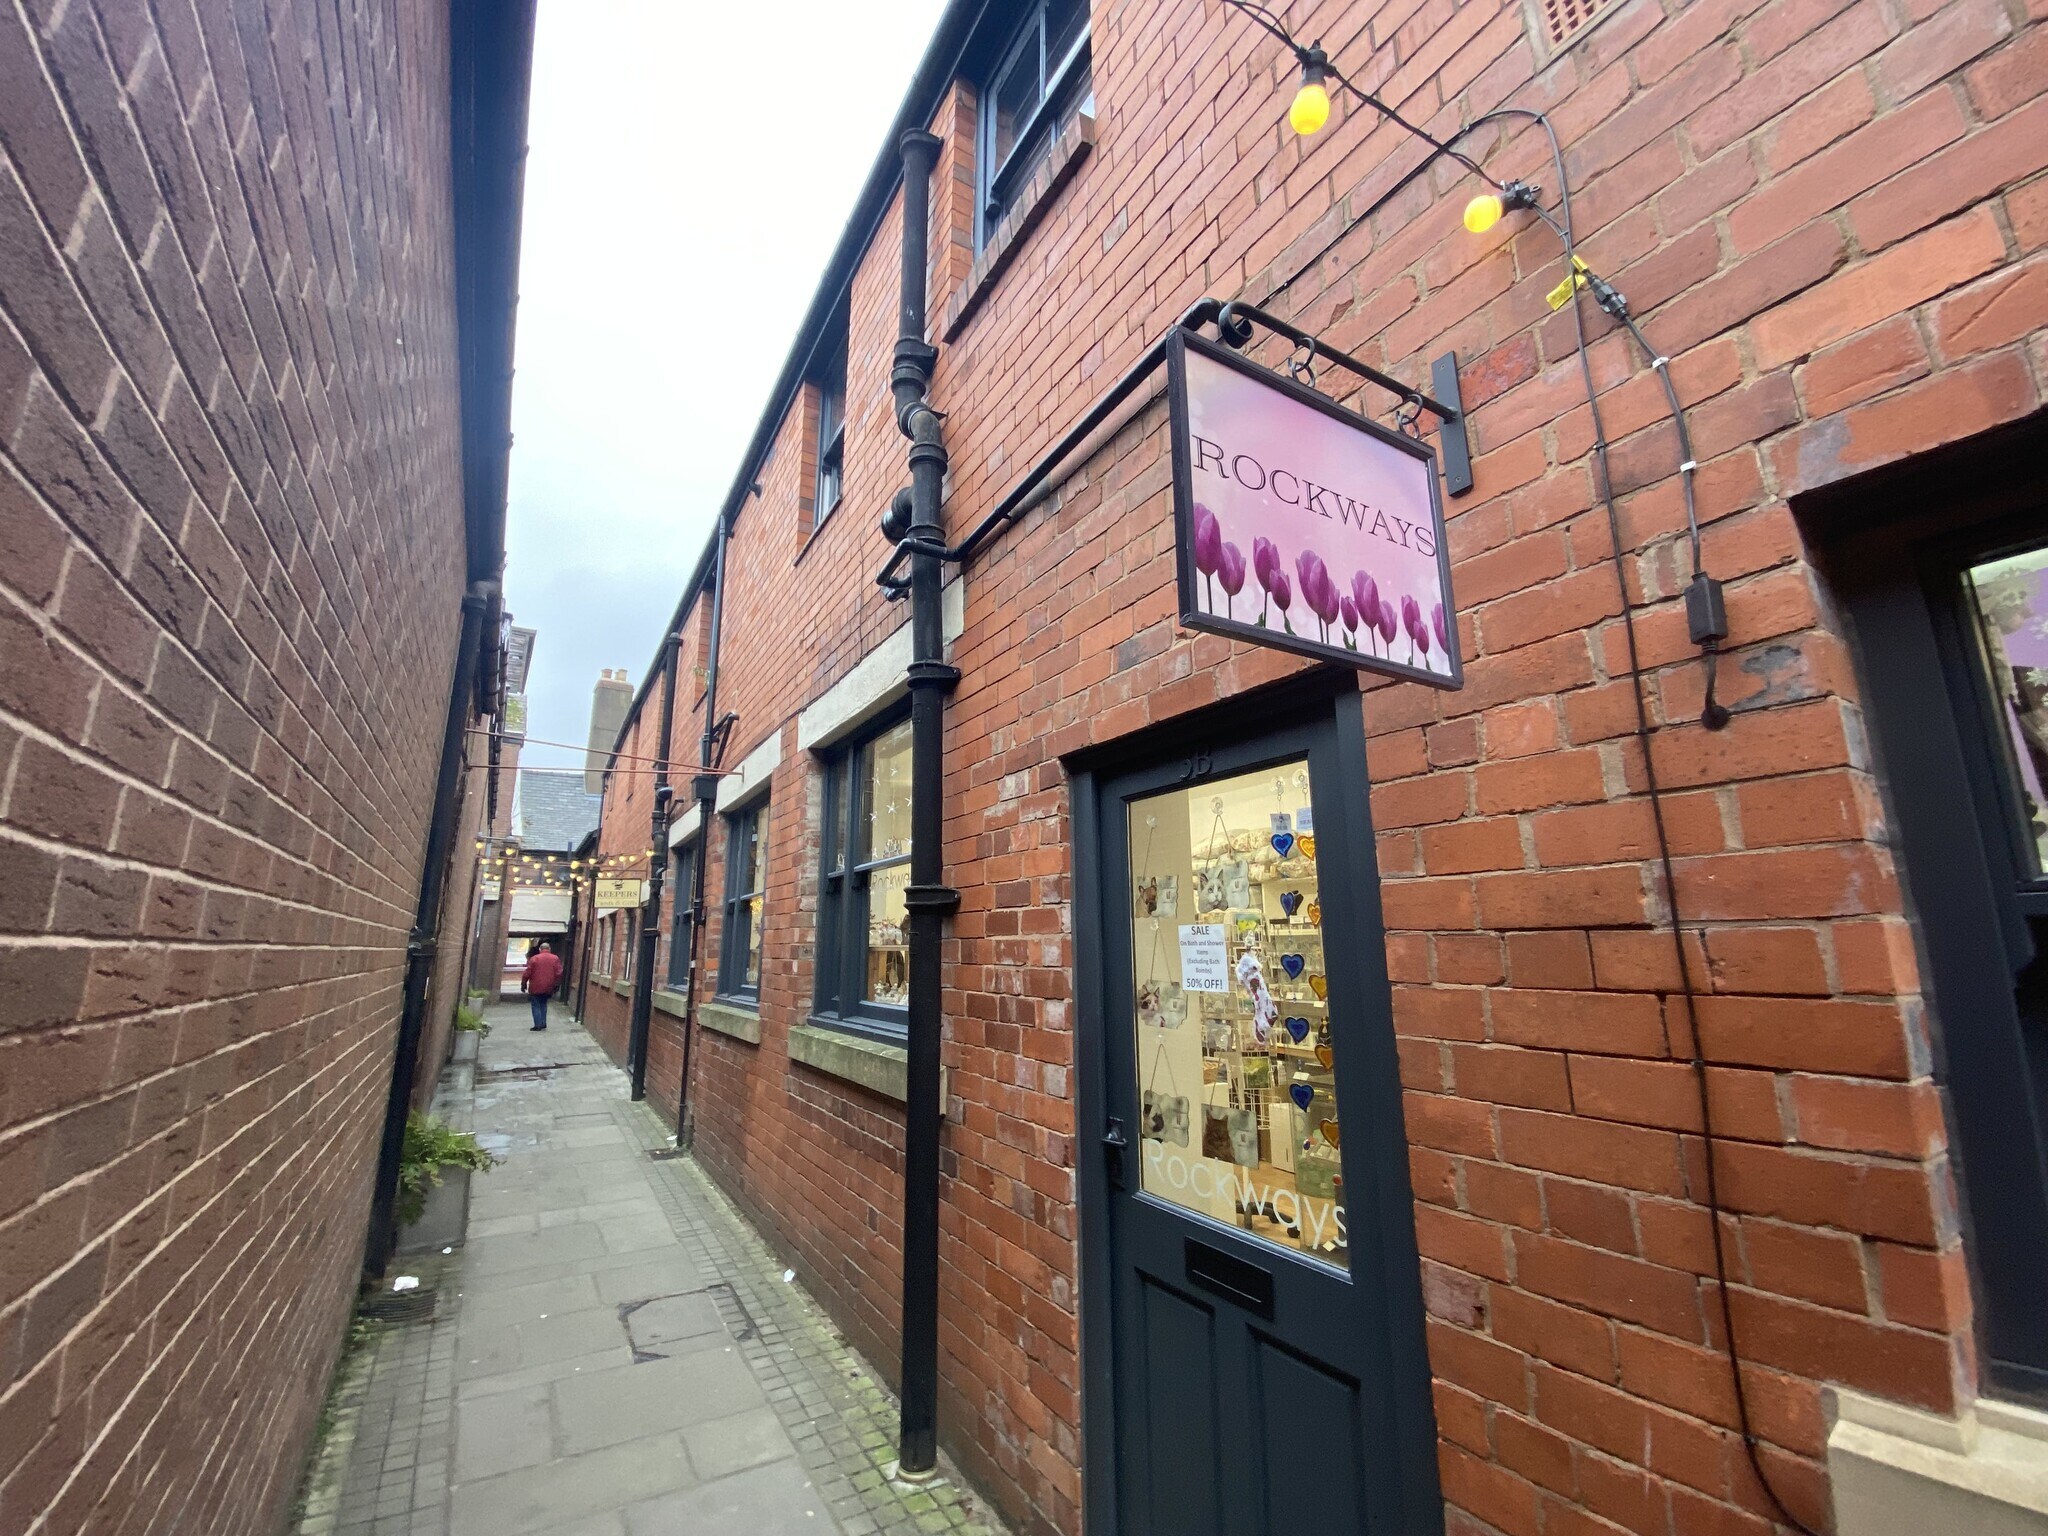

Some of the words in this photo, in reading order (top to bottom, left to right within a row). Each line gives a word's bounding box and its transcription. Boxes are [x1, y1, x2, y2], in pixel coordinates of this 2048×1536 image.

[1192, 434, 1436, 557] ROCKWAYS
[597, 890, 638, 898] KEEPERS
[1191, 925, 1210, 935] SALE
[1186, 978, 1203, 988] 50%
[1204, 978, 1223, 990] OFF!
